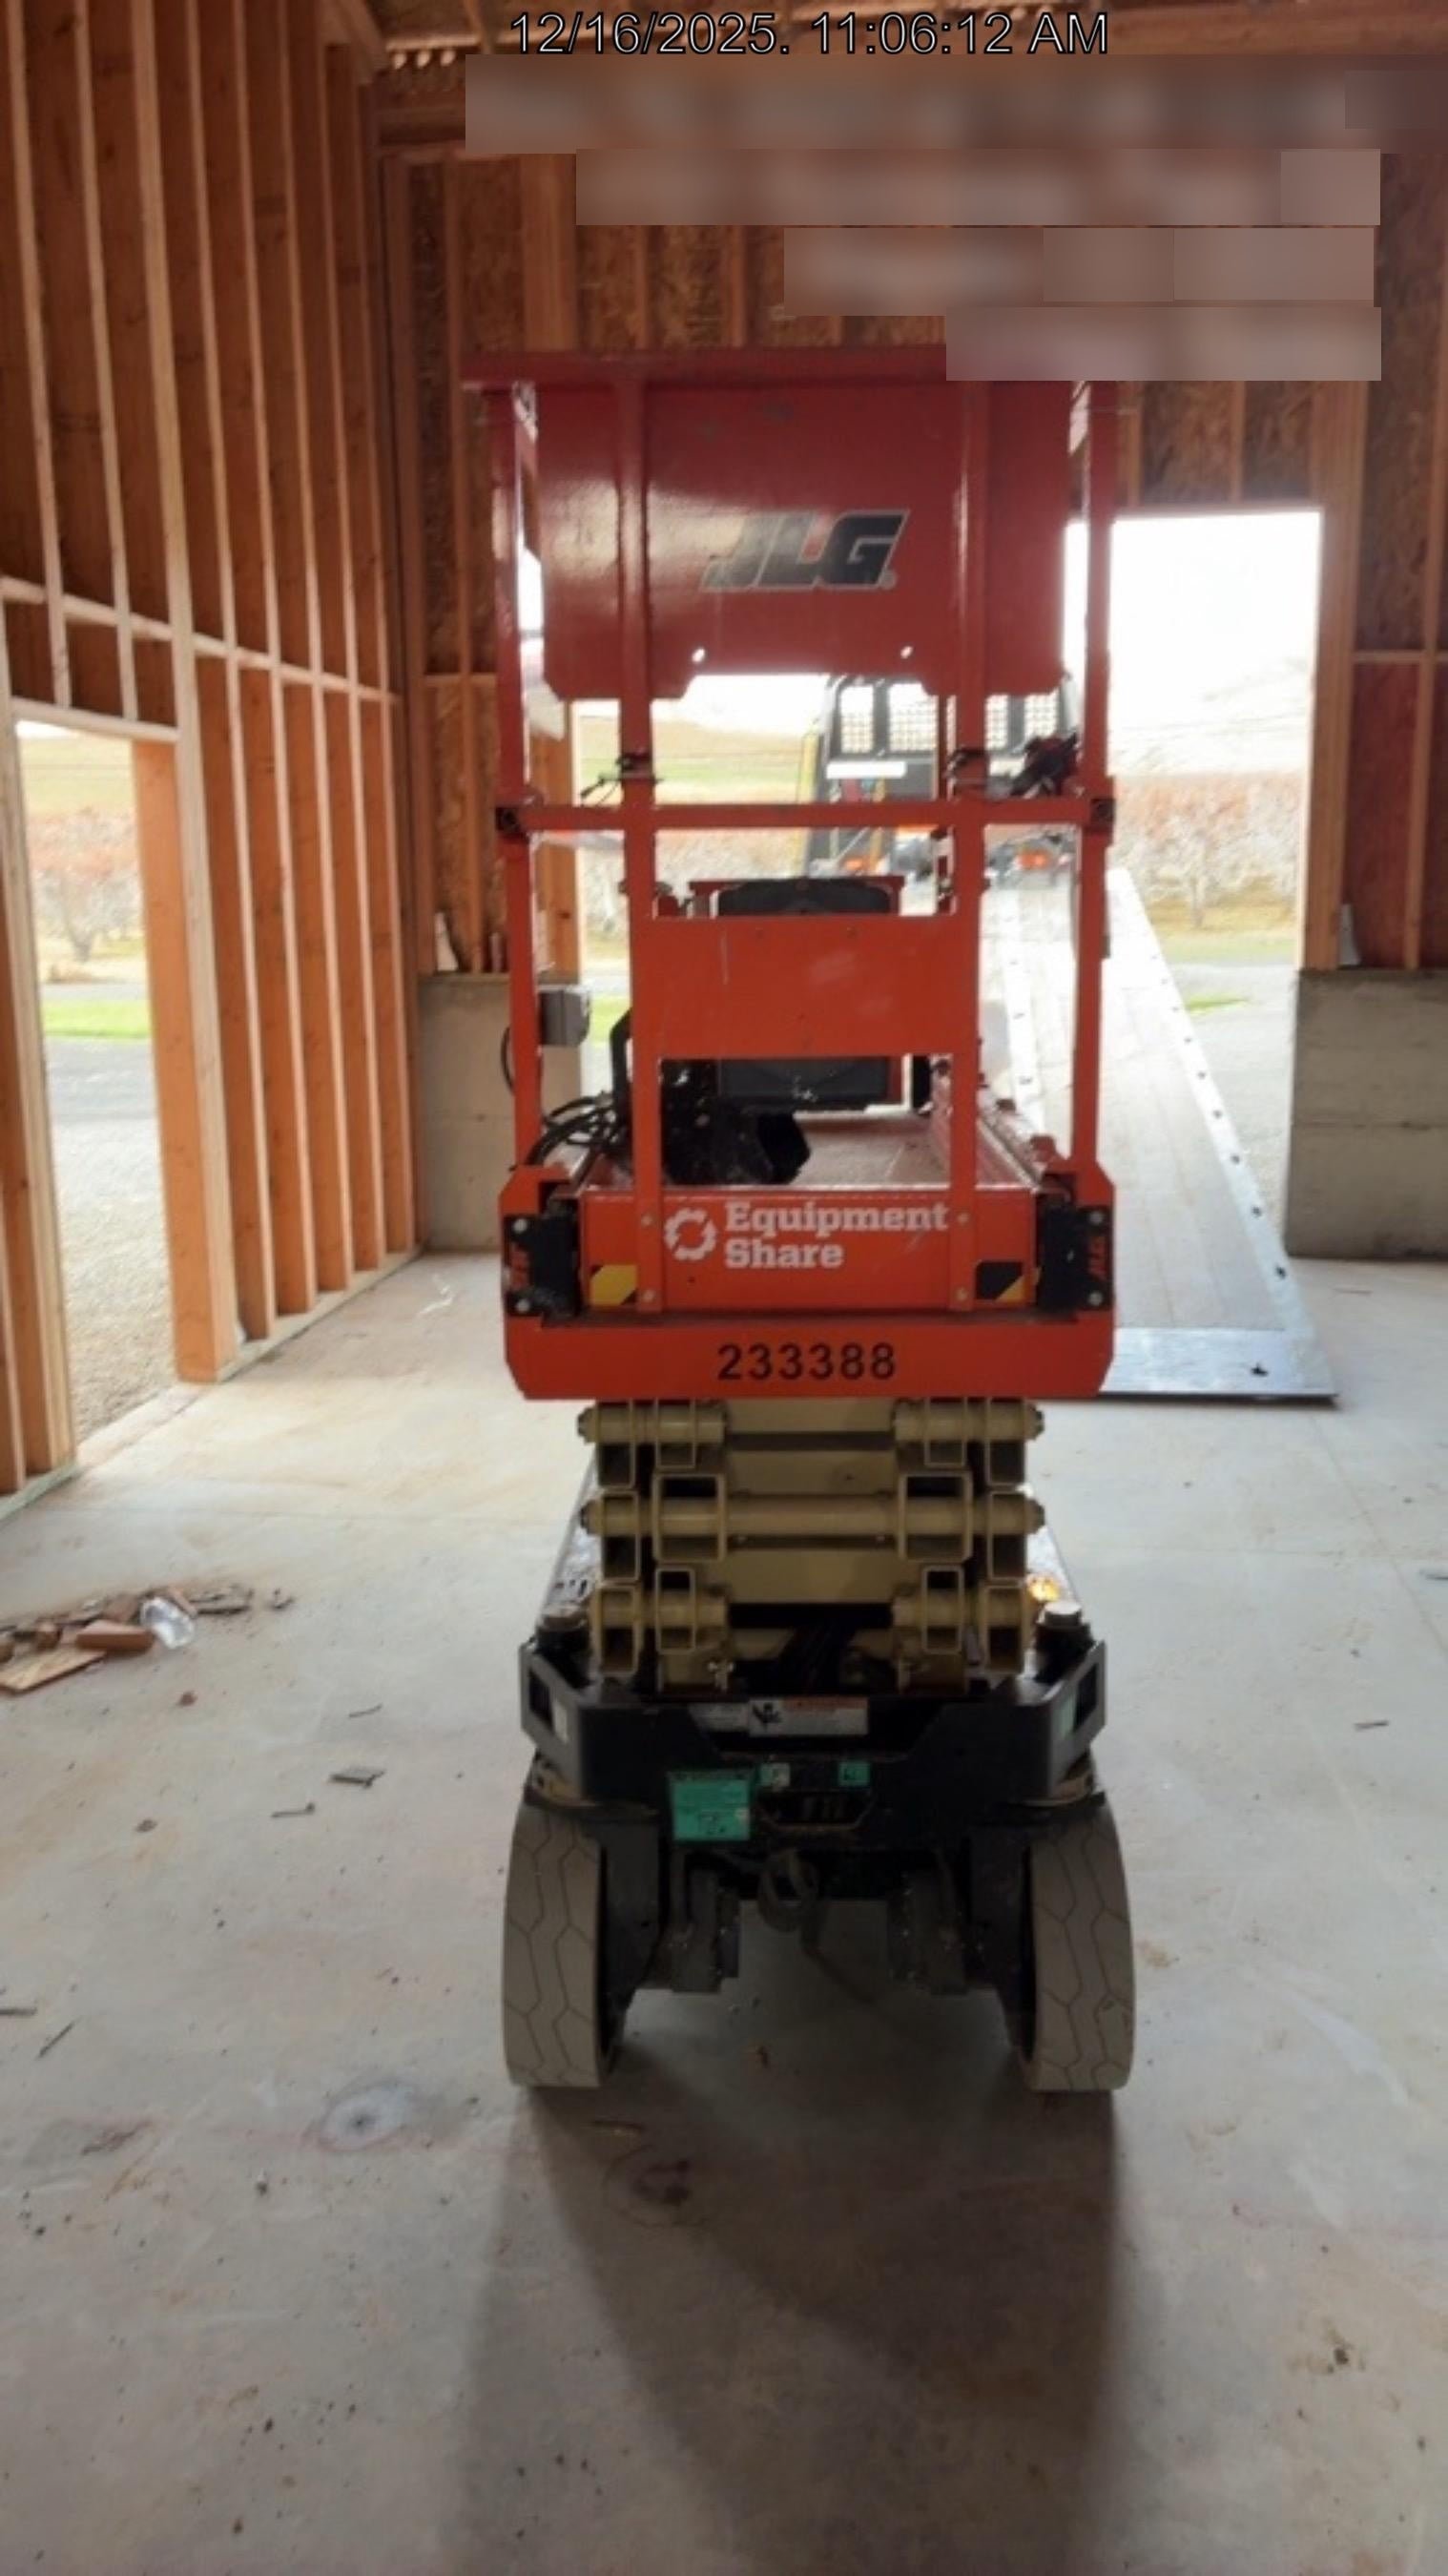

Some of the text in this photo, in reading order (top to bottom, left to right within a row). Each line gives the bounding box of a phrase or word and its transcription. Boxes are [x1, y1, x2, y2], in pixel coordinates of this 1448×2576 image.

[700, 509, 909, 592] JLG
[725, 1201, 949, 1238] Equipment
[725, 1239, 844, 1269] Share
[717, 1341, 896, 1381] 233388
